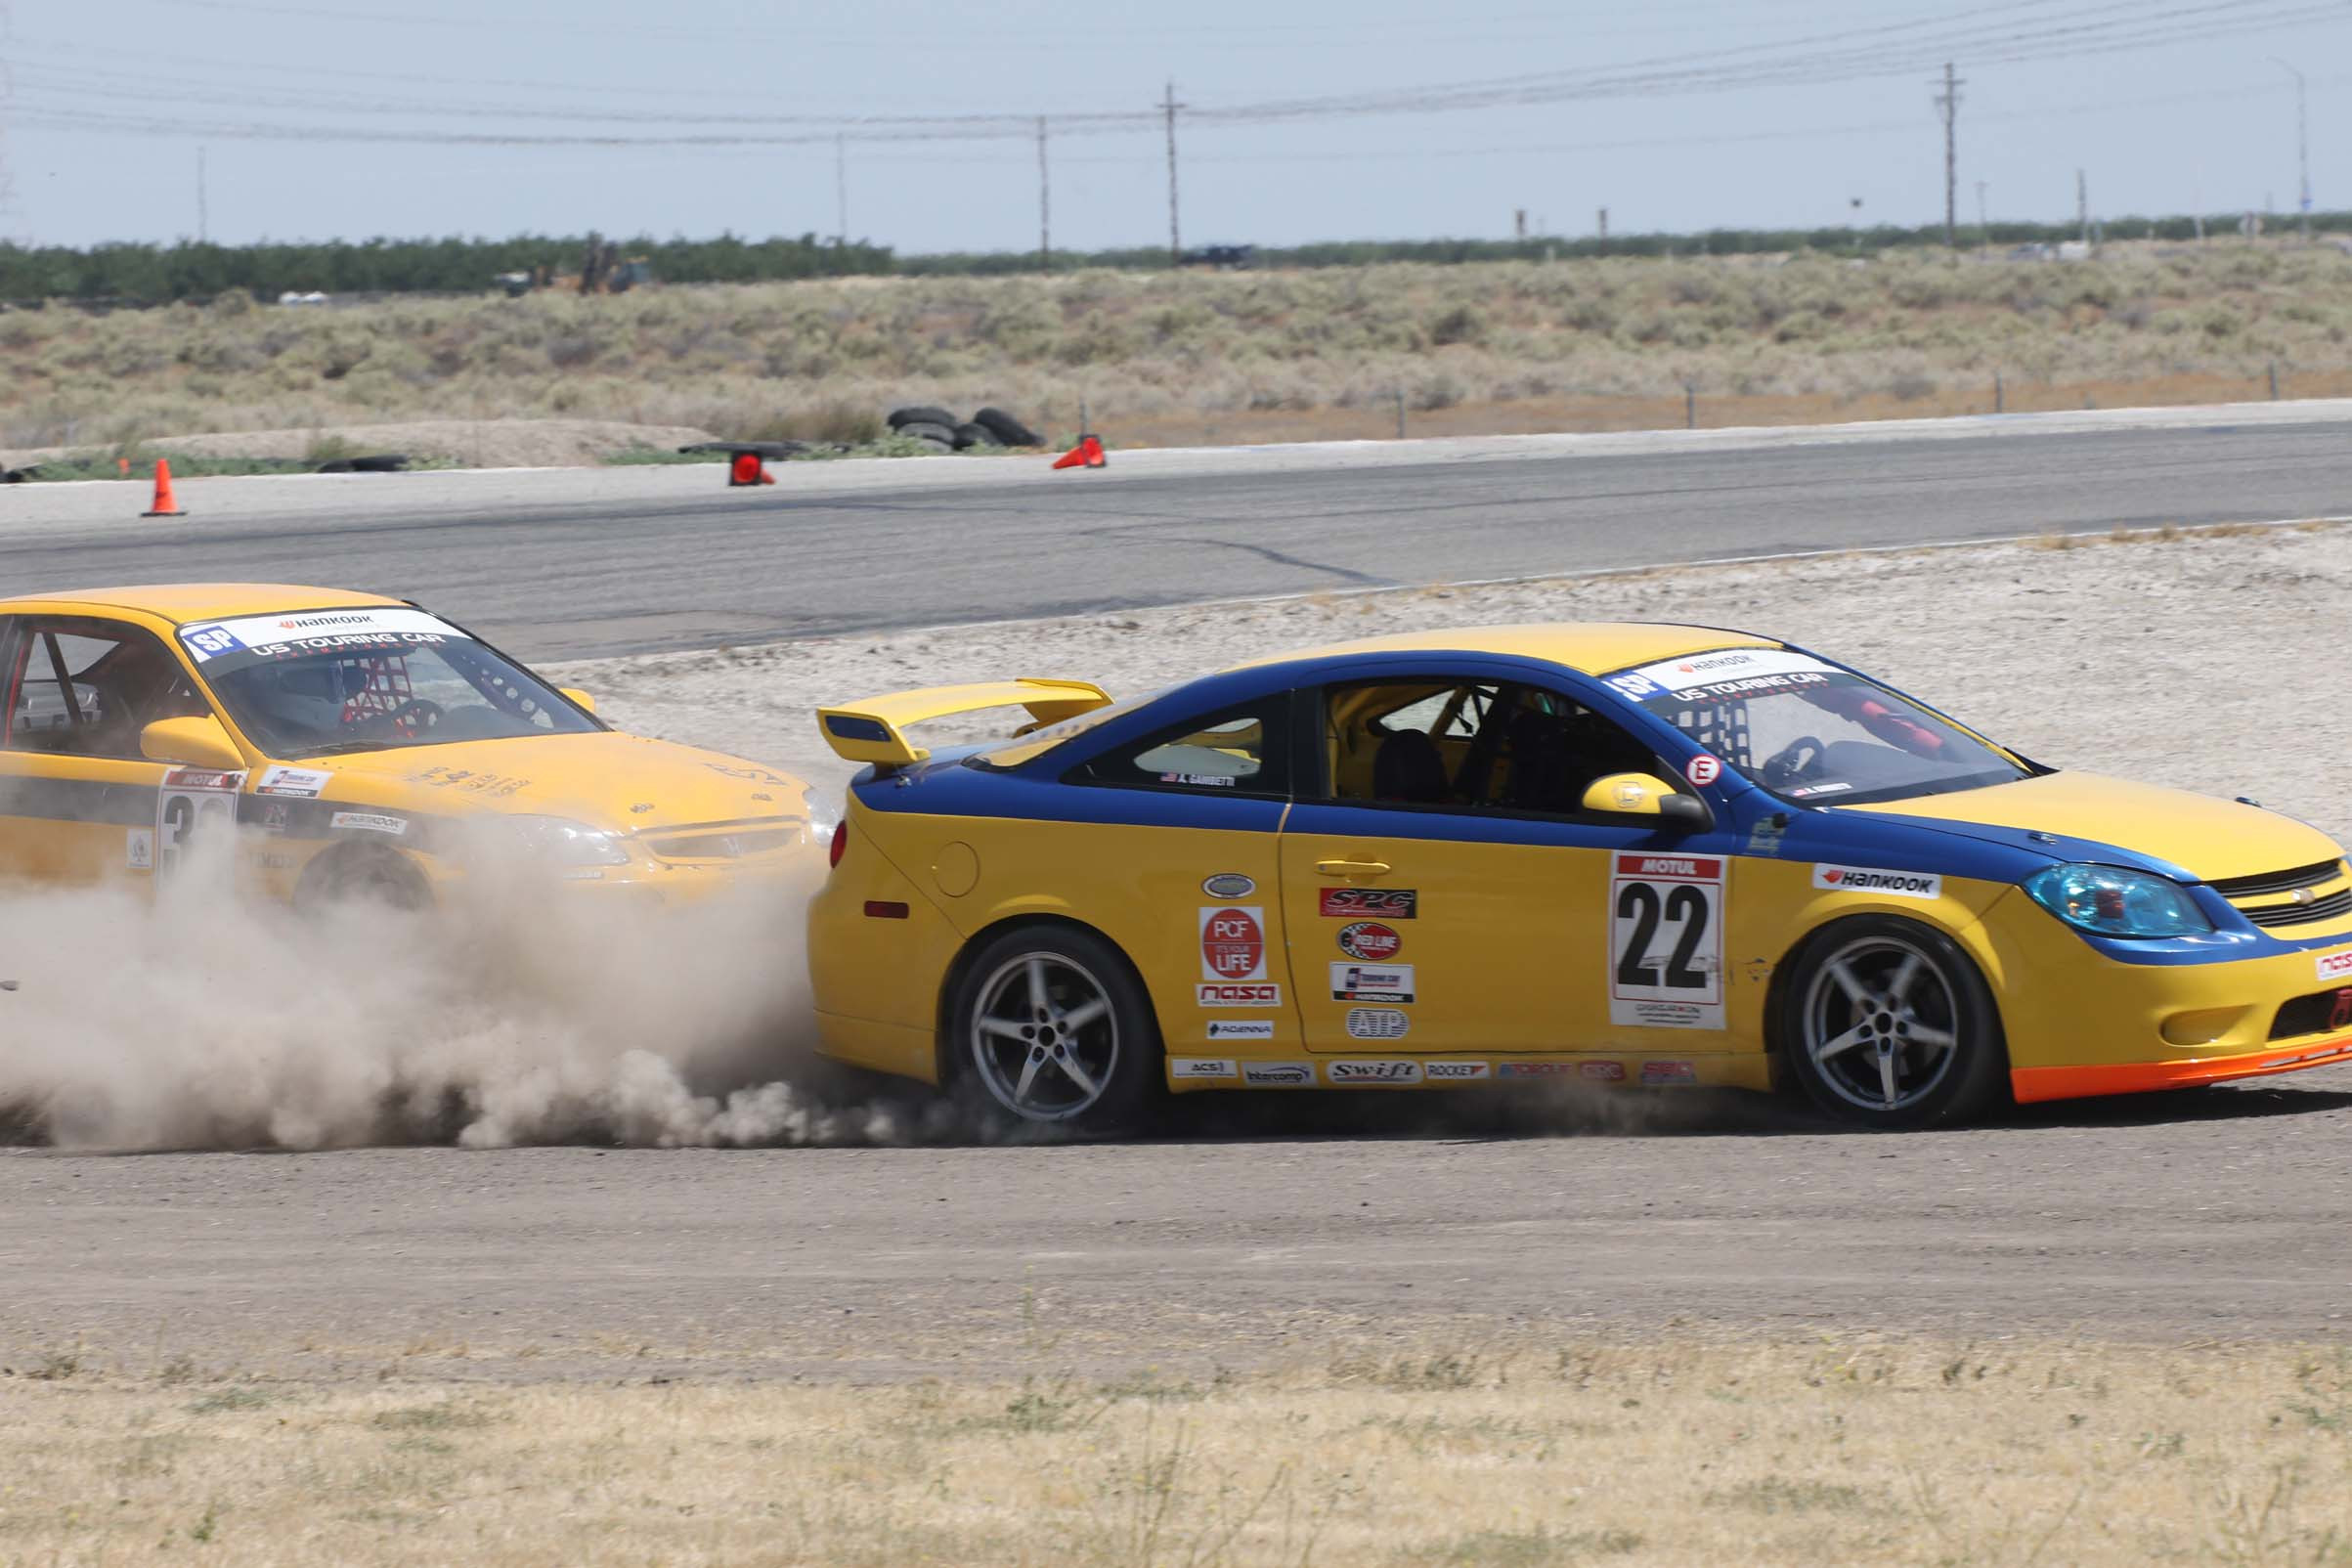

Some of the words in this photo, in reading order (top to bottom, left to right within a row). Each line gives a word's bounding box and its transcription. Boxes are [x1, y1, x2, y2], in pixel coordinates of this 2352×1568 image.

[197, 629, 239, 654] SP
[250, 642, 291, 657] US
[291, 633, 399, 649] TOURING
[400, 633, 447, 643] CAR
[1671, 686, 1704, 702] US
[1704, 675, 1789, 695] TOURING
[1788, 672, 1831, 684] CAR
[1641, 858, 1697, 875] MOTUL
[1617, 882, 1709, 988] 22
[1215, 953, 1251, 972] LIFE
[1245, 1069, 1303, 1082] Intercomp
[1332, 1062, 1416, 1079] Swift
